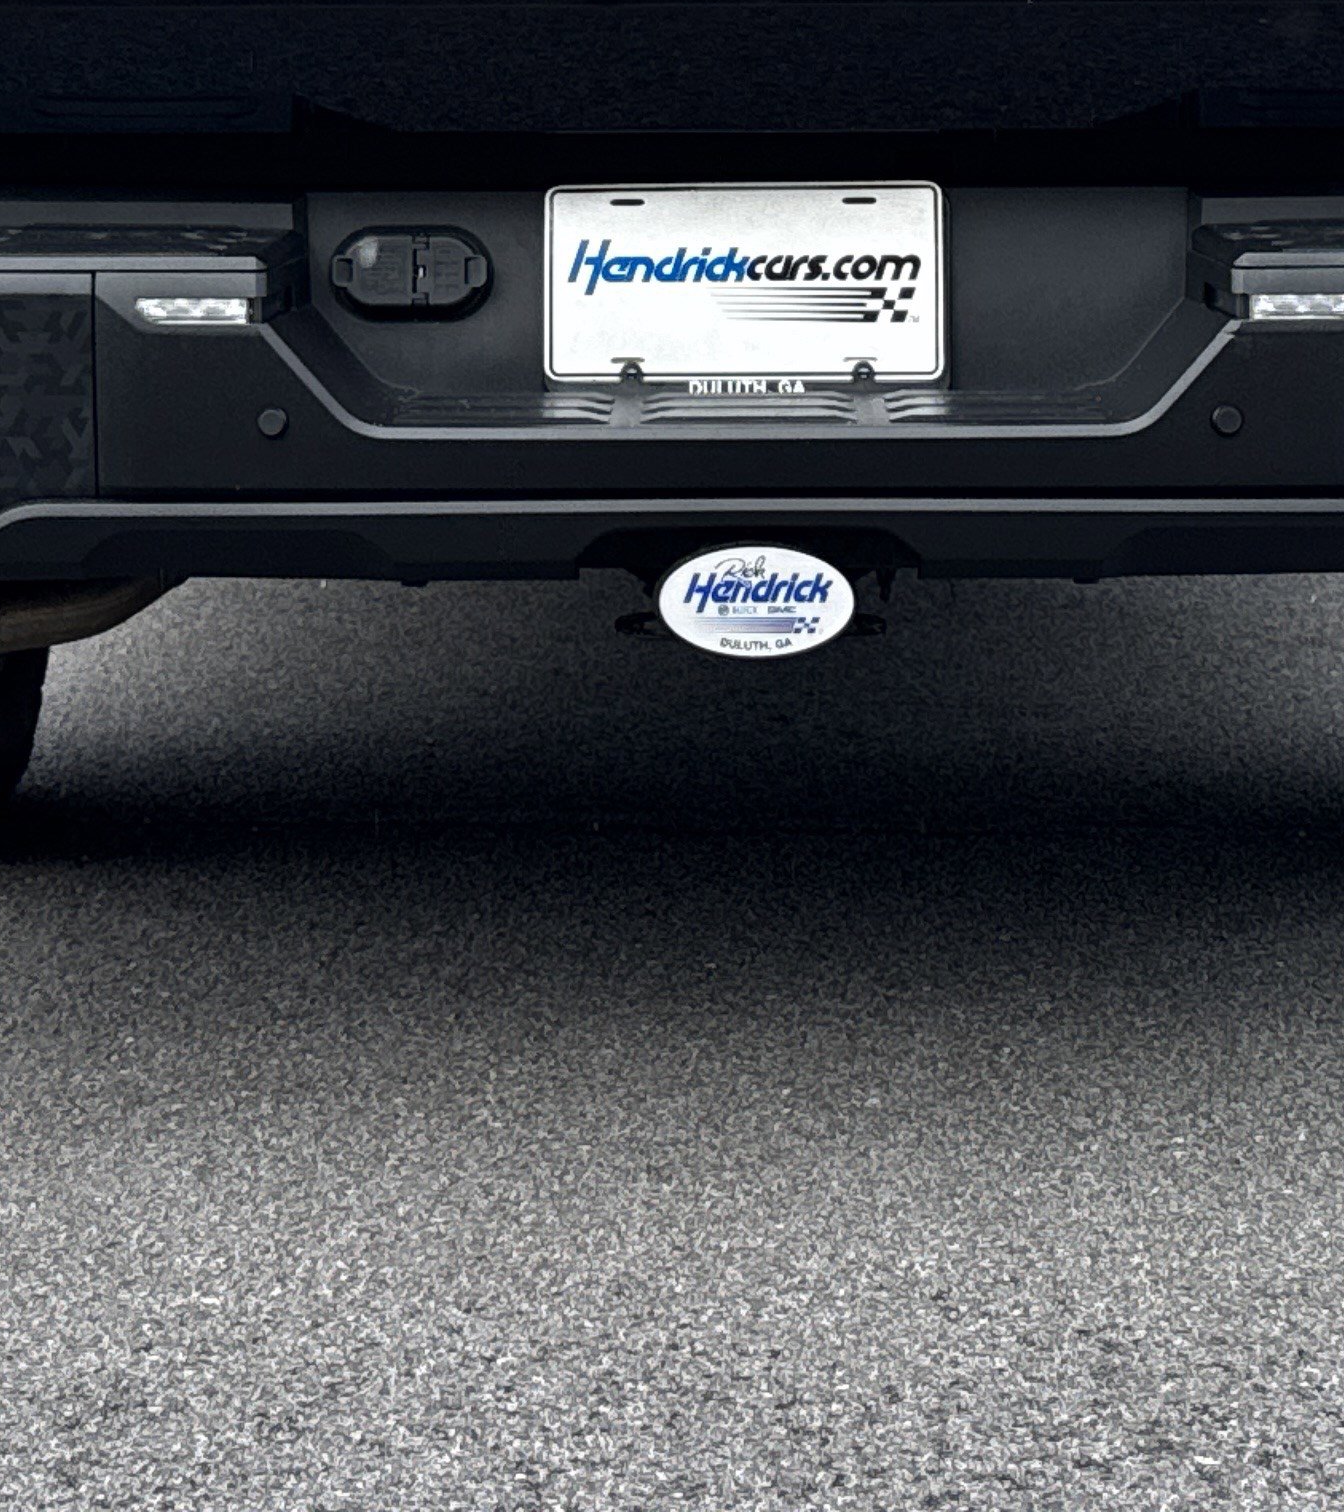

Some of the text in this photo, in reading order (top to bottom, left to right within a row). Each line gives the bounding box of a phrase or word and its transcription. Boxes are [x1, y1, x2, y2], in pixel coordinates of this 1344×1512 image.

[567, 239, 923, 296] Hendrickcars.com
[777, 378, 806, 395] GA
[682, 572, 834, 614] Hendrick
